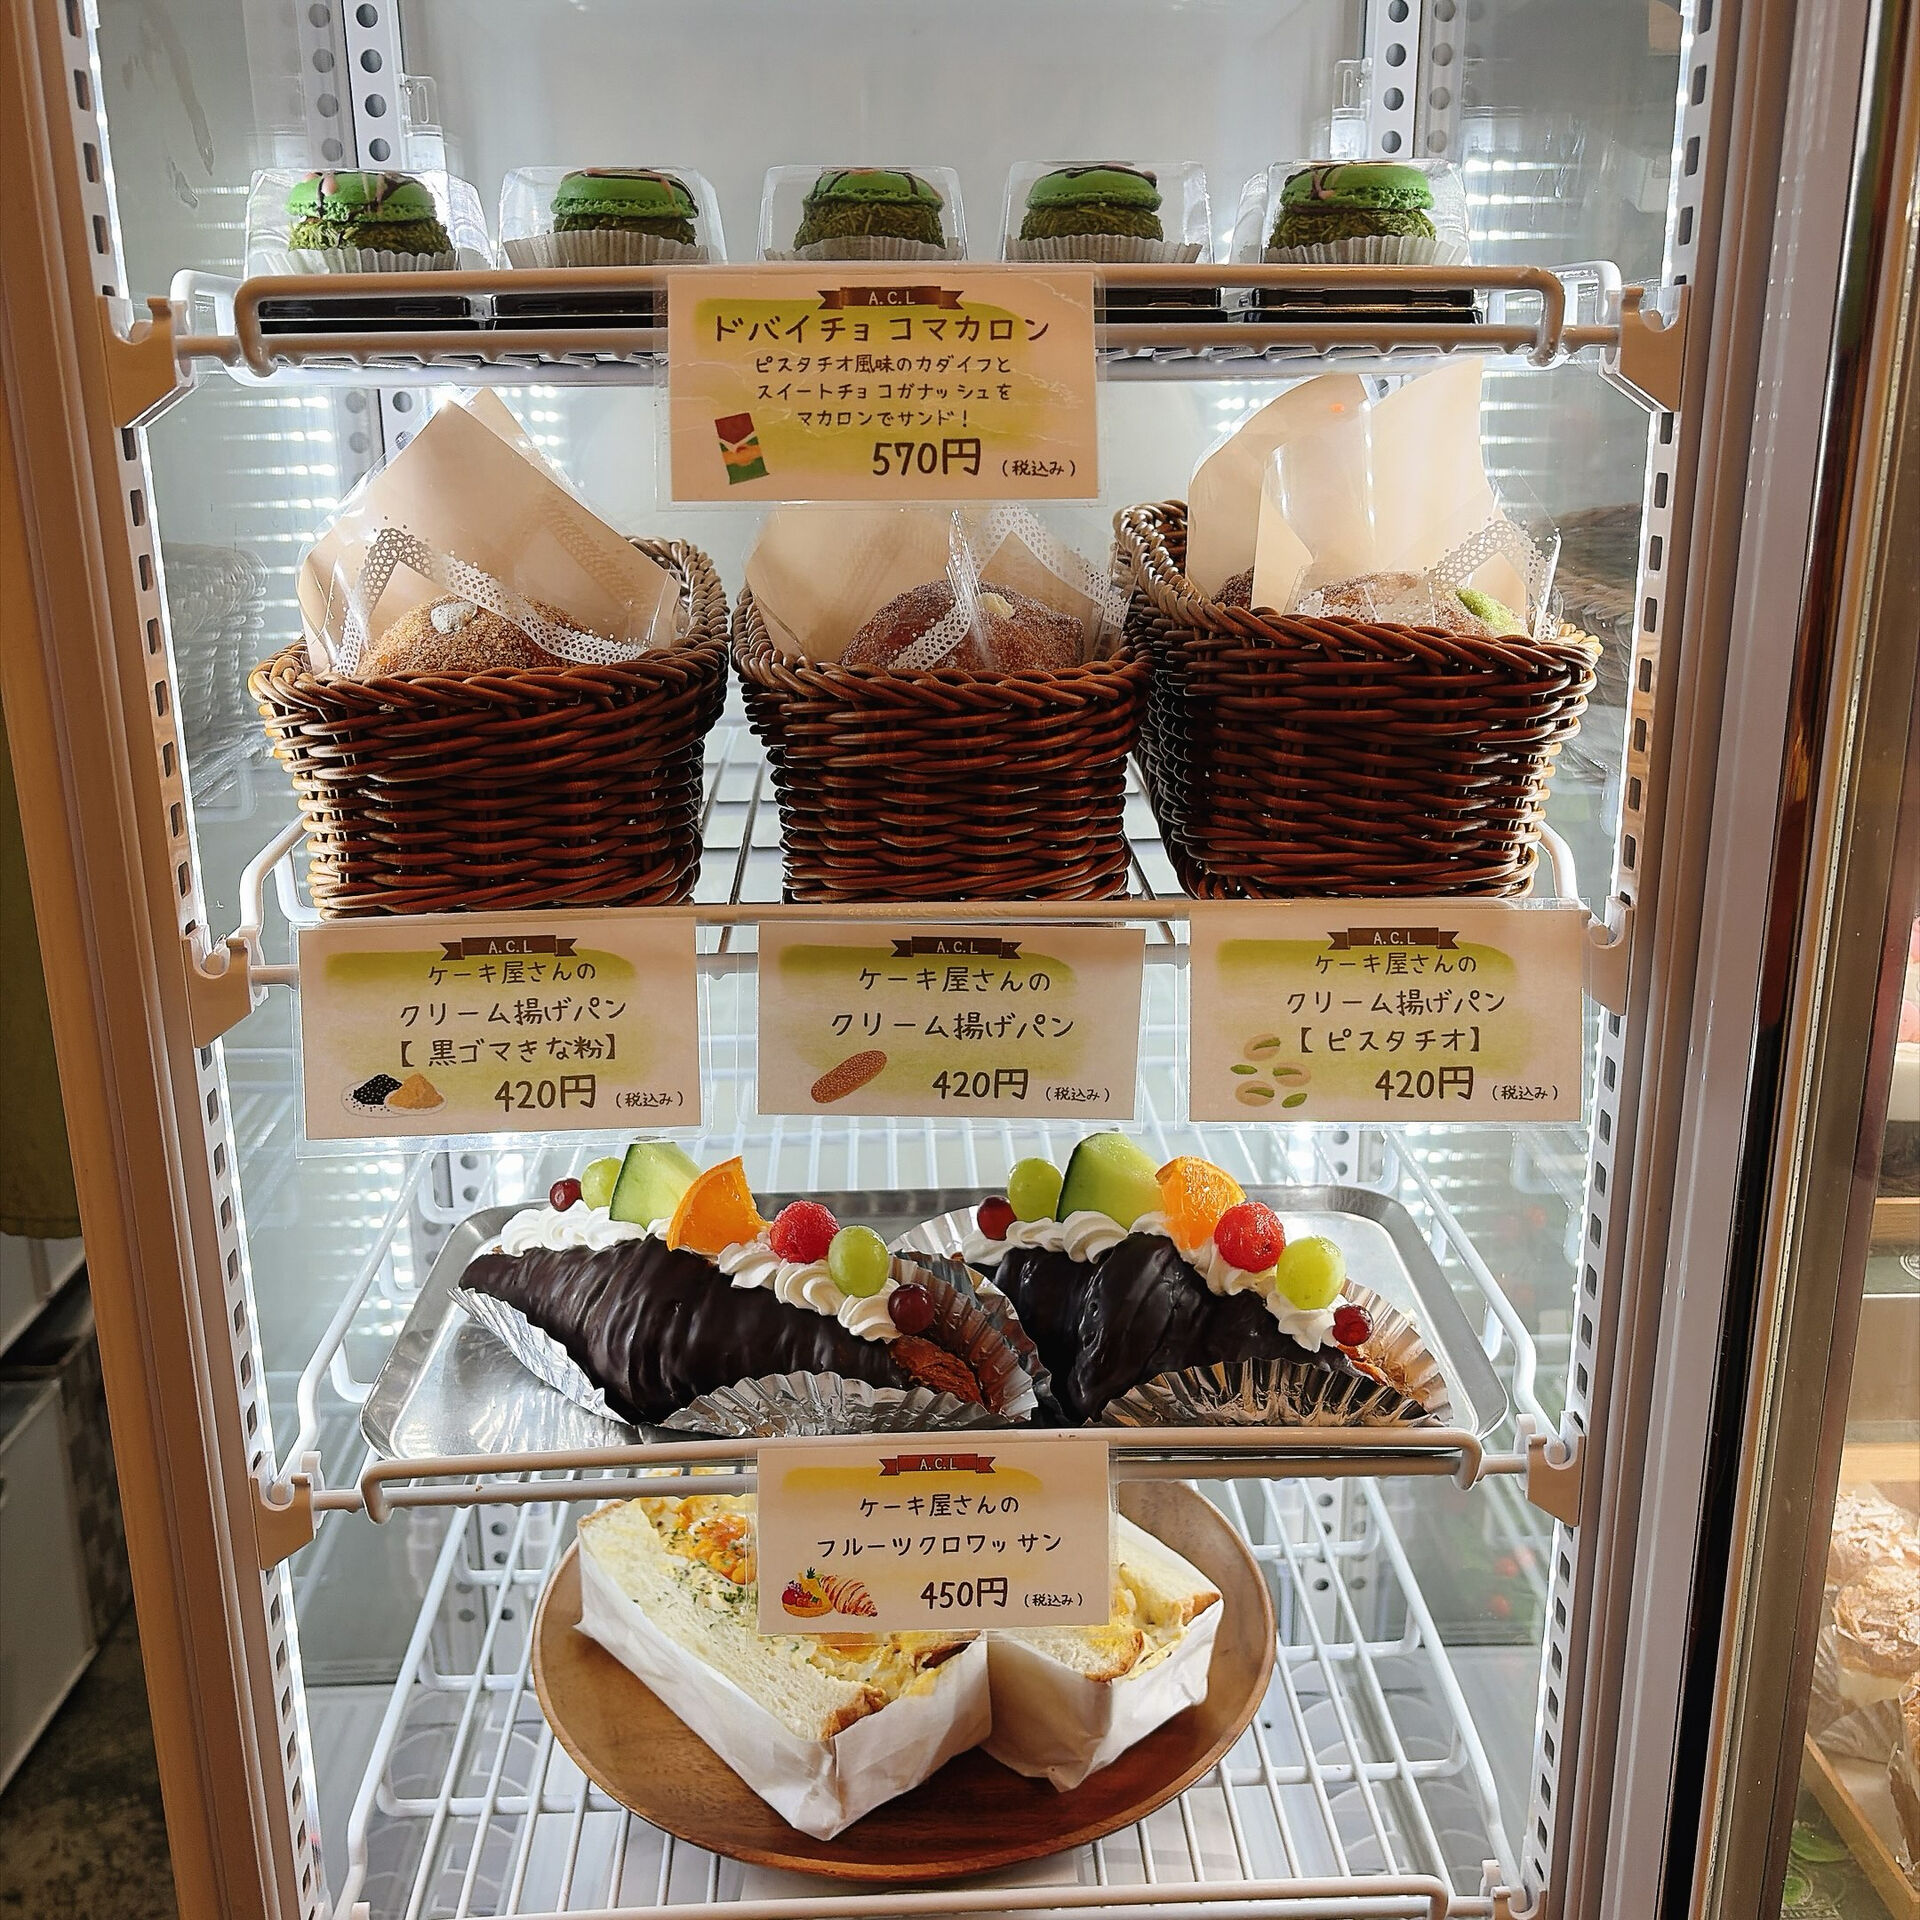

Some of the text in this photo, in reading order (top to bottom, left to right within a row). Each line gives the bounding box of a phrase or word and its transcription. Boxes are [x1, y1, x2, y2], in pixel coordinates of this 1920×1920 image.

[869, 290, 916, 306] A.C.L
[715, 315, 1049, 343] ドバイチョコマカロン
[755, 355, 1011, 374] ピスタチオ風味のカダイフと
[757, 383, 1012, 401] スイートチョコガナッシュを
[873, 438, 982, 476] 570円
[489, 940, 533, 954] A.C.L
[937, 940, 979, 955] A.C.L
[1374, 931, 1416, 945] A.C.L
[428, 961, 596, 986] ケーキ屋さんの
[1315, 952, 1476, 975] ケーキ屋さんの
[859, 966, 1050, 992] ケーキ屋さんの
[400, 997, 626, 1028] クリーム揚げパン
[1287, 989, 1505, 1016] クリーム揚げパン
[831, 1012, 1074, 1040] クリーム揚げパン
[494, 1074, 596, 1112] 420円
[932, 1069, 1028, 1100] 420円
[1375, 1066, 1473, 1101] 420円
[919, 1458, 957, 1471] A.C.L
[859, 1494, 1019, 1517] ケーキ屋さんの
[817, 1534, 1062, 1557] フルーツクロワッサン
[920, 1577, 1008, 1609] 450円
